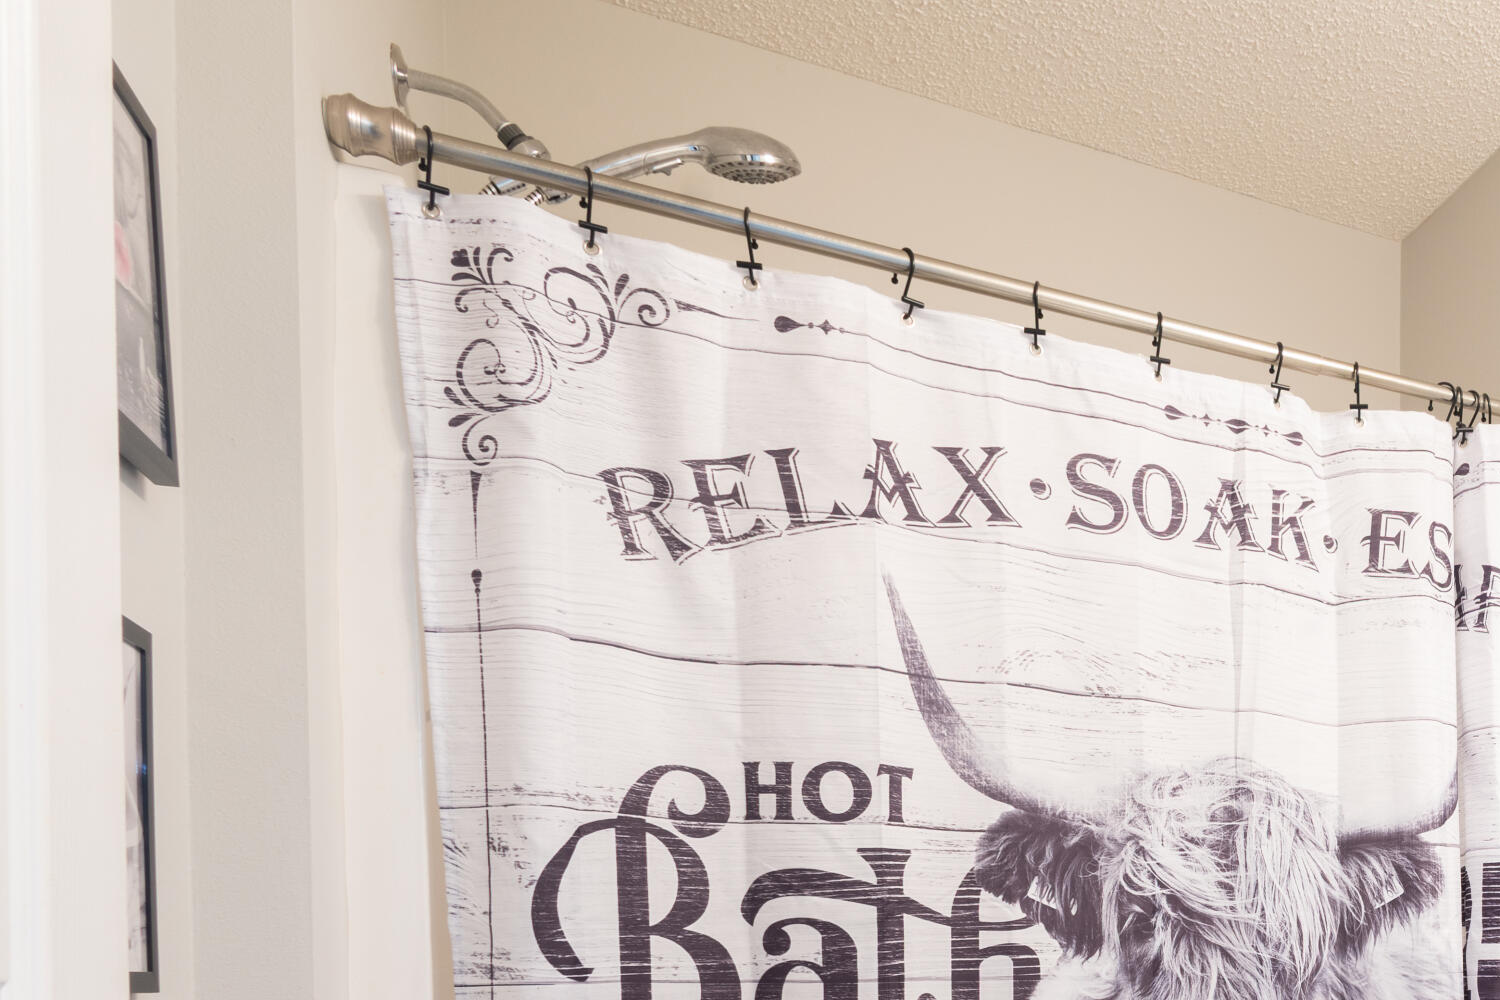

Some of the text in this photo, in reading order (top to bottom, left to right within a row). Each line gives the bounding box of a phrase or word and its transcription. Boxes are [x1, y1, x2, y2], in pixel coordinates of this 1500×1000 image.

[597, 438, 1023, 565] RELAX
[1066, 452, 1320, 573] SOAK
[742, 761, 914, 822] HOT
